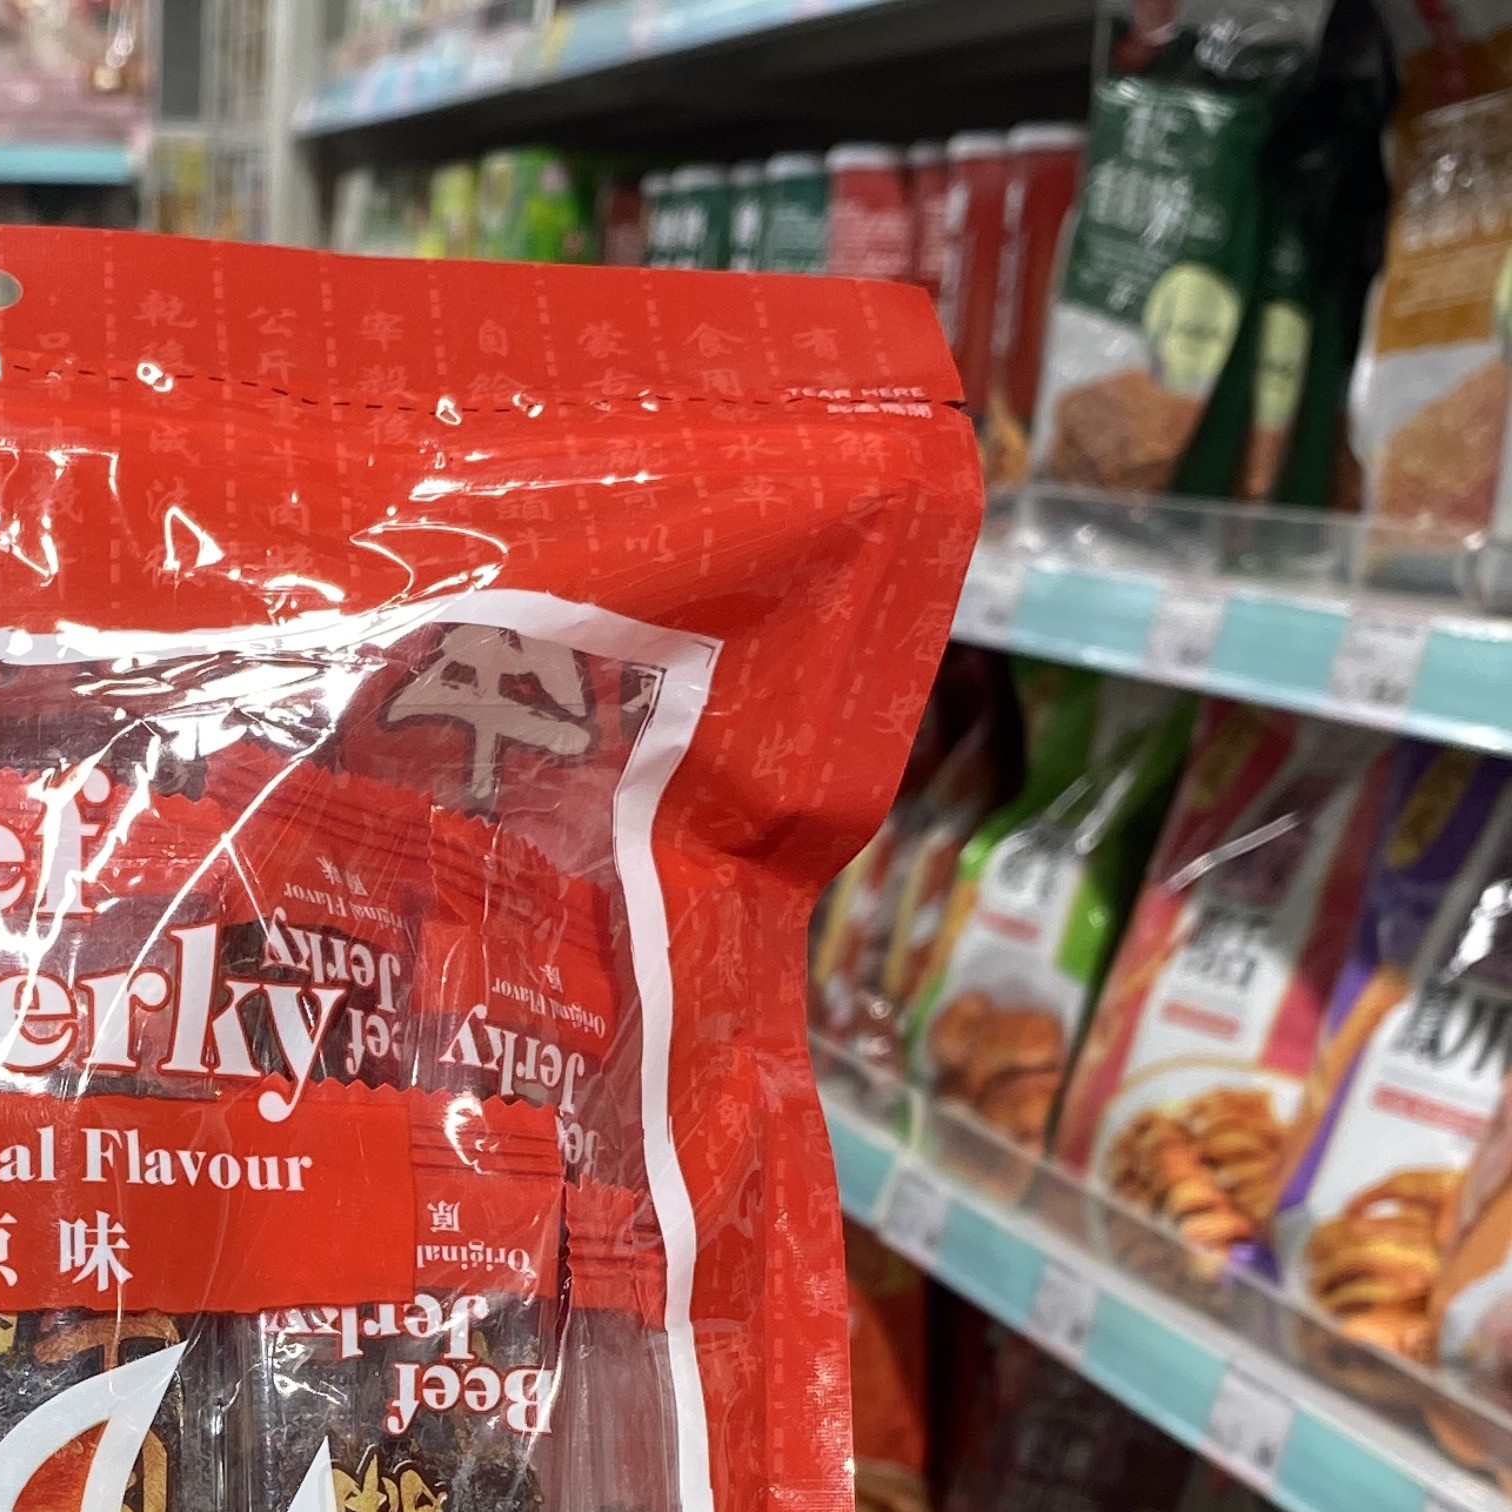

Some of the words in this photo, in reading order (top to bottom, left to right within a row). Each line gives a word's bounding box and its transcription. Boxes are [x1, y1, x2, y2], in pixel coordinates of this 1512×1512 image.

[261, 906, 401, 1013] Jerky
[438, 1003, 586, 1115] Jerky
[84, 1126, 313, 1195] Flavour
[416, 1239, 530, 1272] Original
[385, 1362, 553, 1436] Beef
